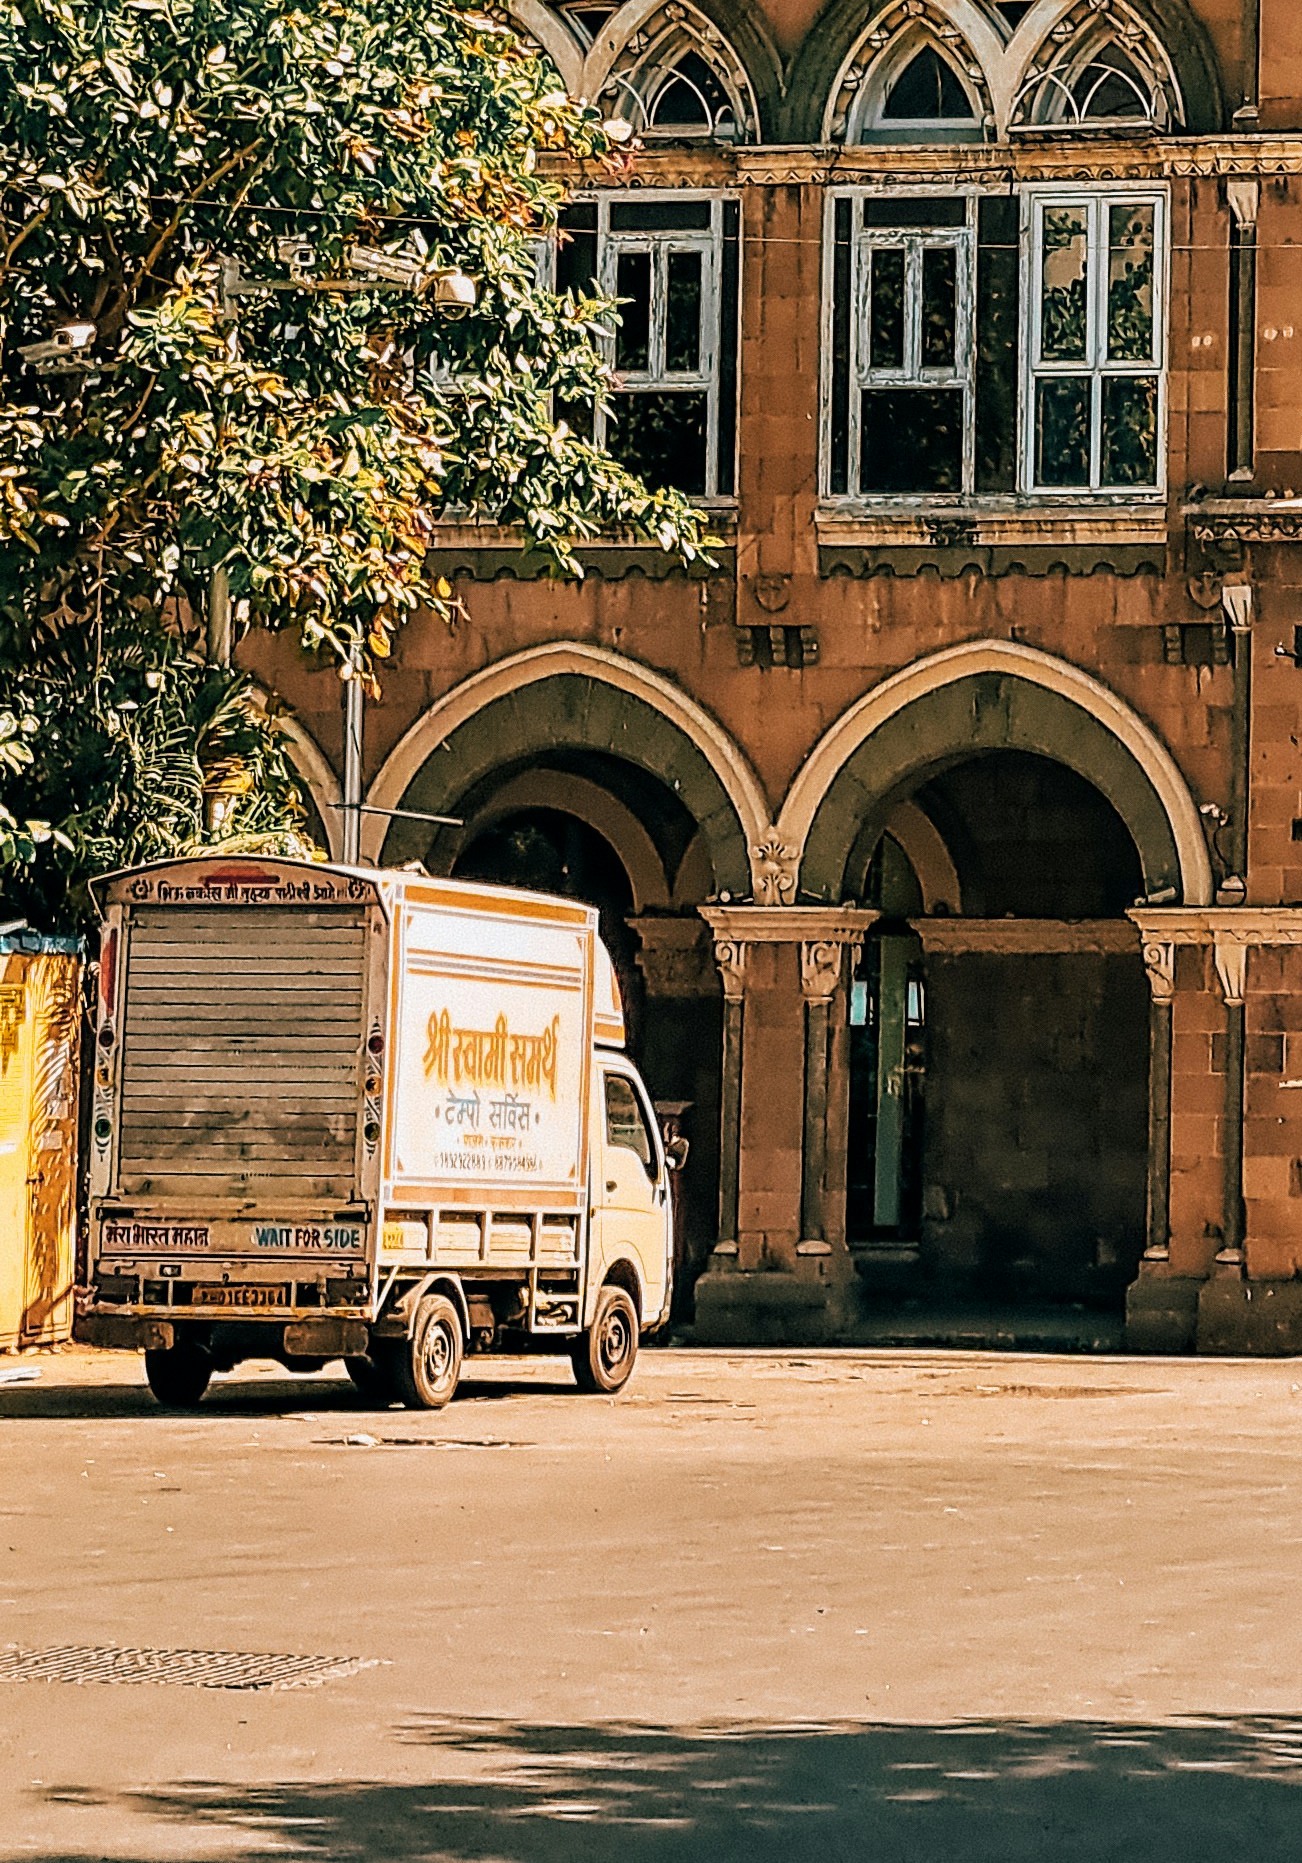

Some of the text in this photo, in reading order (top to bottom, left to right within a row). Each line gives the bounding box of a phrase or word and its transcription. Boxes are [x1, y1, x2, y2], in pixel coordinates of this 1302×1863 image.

[422, 1008, 560, 1104] श्री स्वामी समर्थ
[445, 1088, 531, 1131] टेम्पो सर्विस
[132, 1224, 170, 1246] भारत
[171, 1227, 209, 1247] महान
[255, 1227, 293, 1248] WAIT
[295, 1228, 321, 1248] FOR
[323, 1229, 360, 1249] SIDE
